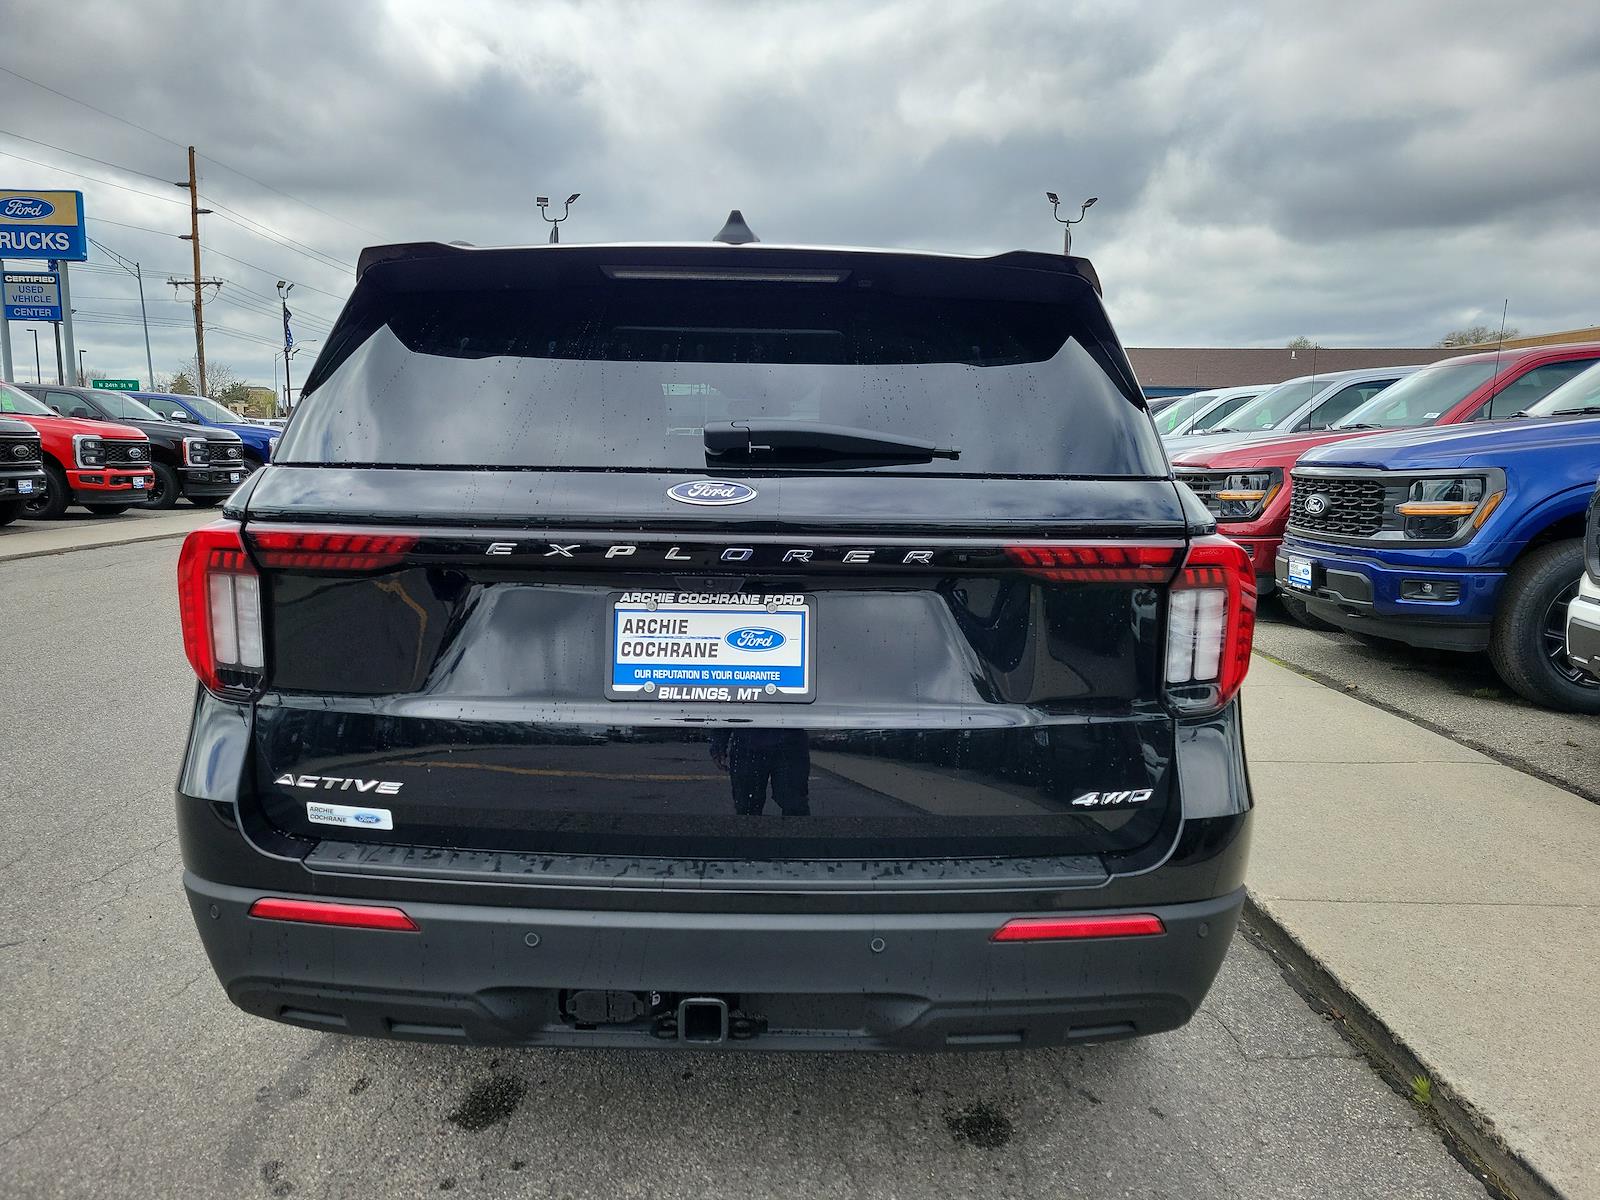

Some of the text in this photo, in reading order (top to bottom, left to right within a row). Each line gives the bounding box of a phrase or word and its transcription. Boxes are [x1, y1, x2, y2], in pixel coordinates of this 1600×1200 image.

[5, 199, 42, 216] Ford
[4, 275, 56, 283] CERTIFIED
[18, 285, 44, 294] USED
[12, 295, 52, 303] VEHICLE
[13, 307, 52, 317] CENTER
[687, 481, 737, 499] Ford
[485, 542, 935, 564] EXPLORER
[619, 592, 805, 606] ARCHIE COCHRANE FORD
[622, 618, 689, 635] ARCHIE
[737, 629, 774, 647] Ford
[620, 641, 719, 658] COCHRANE
[634, 669, 781, 681] OUR REPUTATION IS YOUR GUARANTEE
[658, 687, 762, 701] BILLINGS, MT
[274, 773, 404, 795] ACTIVE
[1071, 788, 1154, 806] 4WD
[309, 806, 334, 814] ARCHIE
[309, 813, 347, 823] COCHRANE
